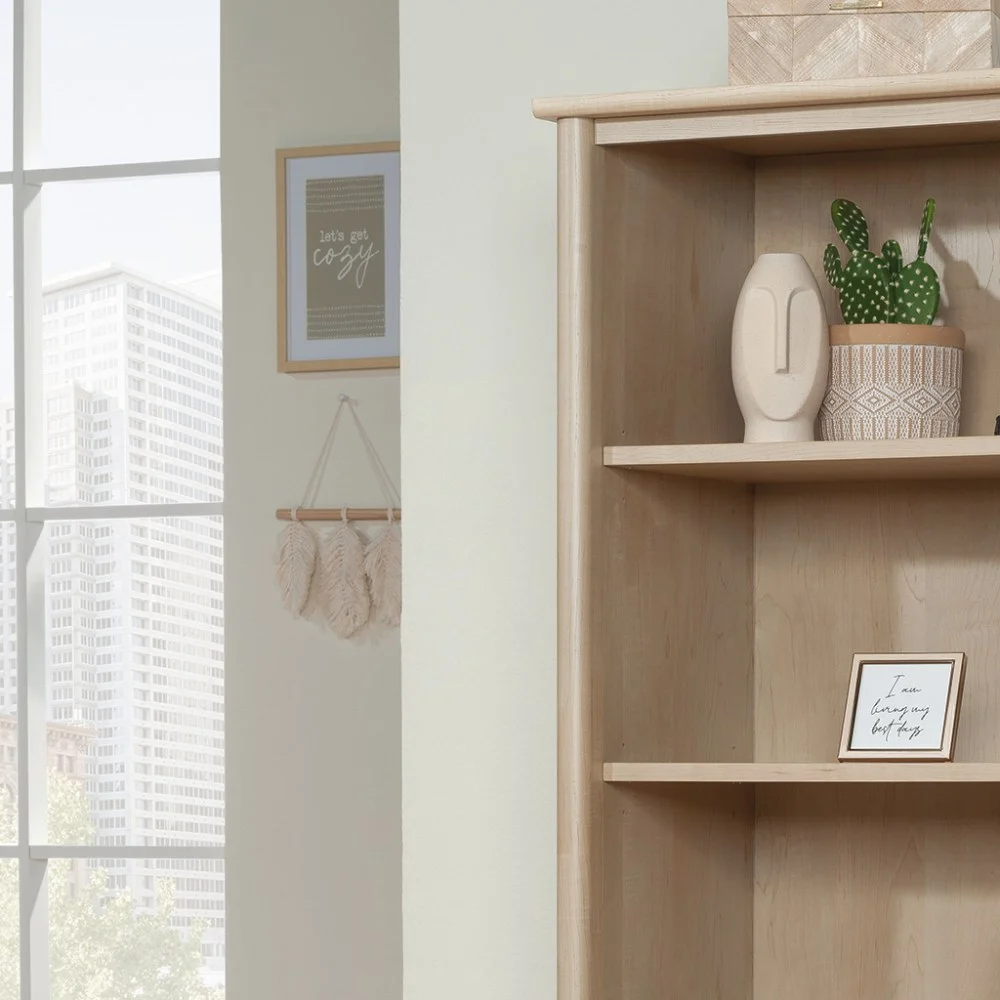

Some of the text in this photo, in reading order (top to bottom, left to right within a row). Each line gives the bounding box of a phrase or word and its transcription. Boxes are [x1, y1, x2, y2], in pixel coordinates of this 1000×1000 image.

[319, 228, 369, 244] let's get
[312, 242, 380, 289] cozy
[911, 706, 930, 721] my
[871, 718, 924, 742] best days
